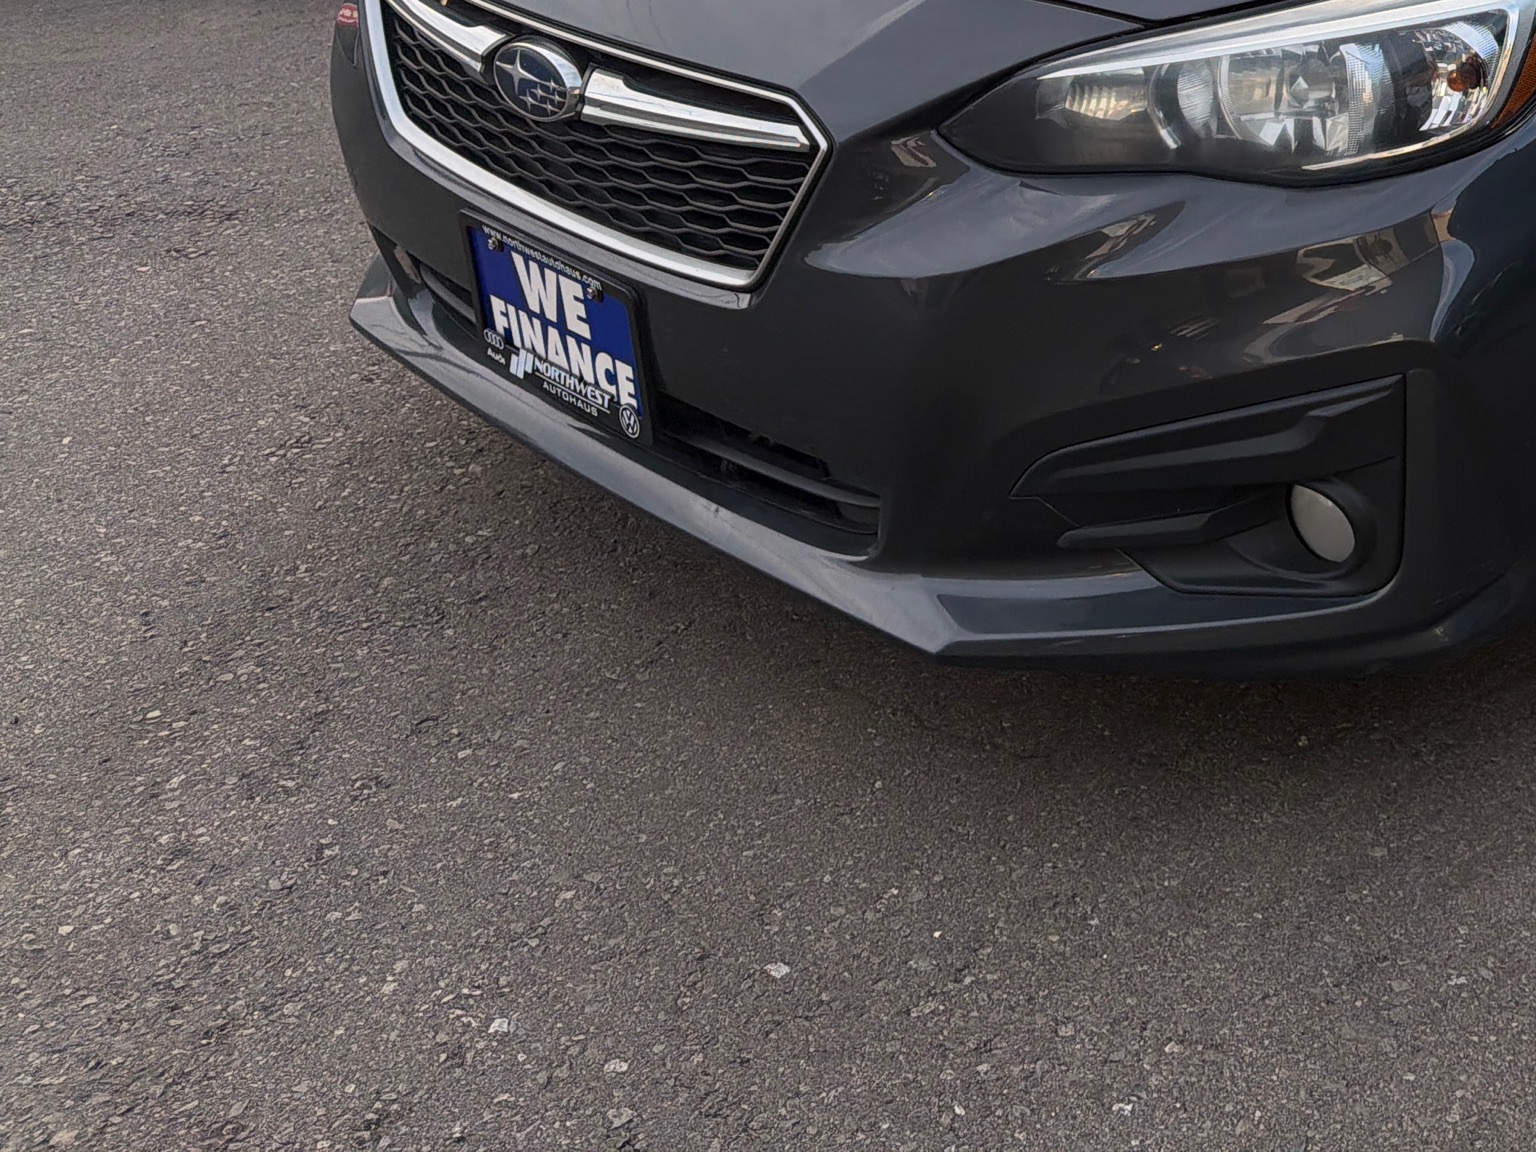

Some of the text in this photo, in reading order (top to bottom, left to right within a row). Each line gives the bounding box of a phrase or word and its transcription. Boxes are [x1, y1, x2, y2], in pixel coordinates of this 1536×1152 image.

[511, 250, 592, 340] WE
[490, 295, 638, 410] FINANCE
[534, 357, 611, 409] NORTHWEST
[543, 381, 598, 417] AUTOHAUS
